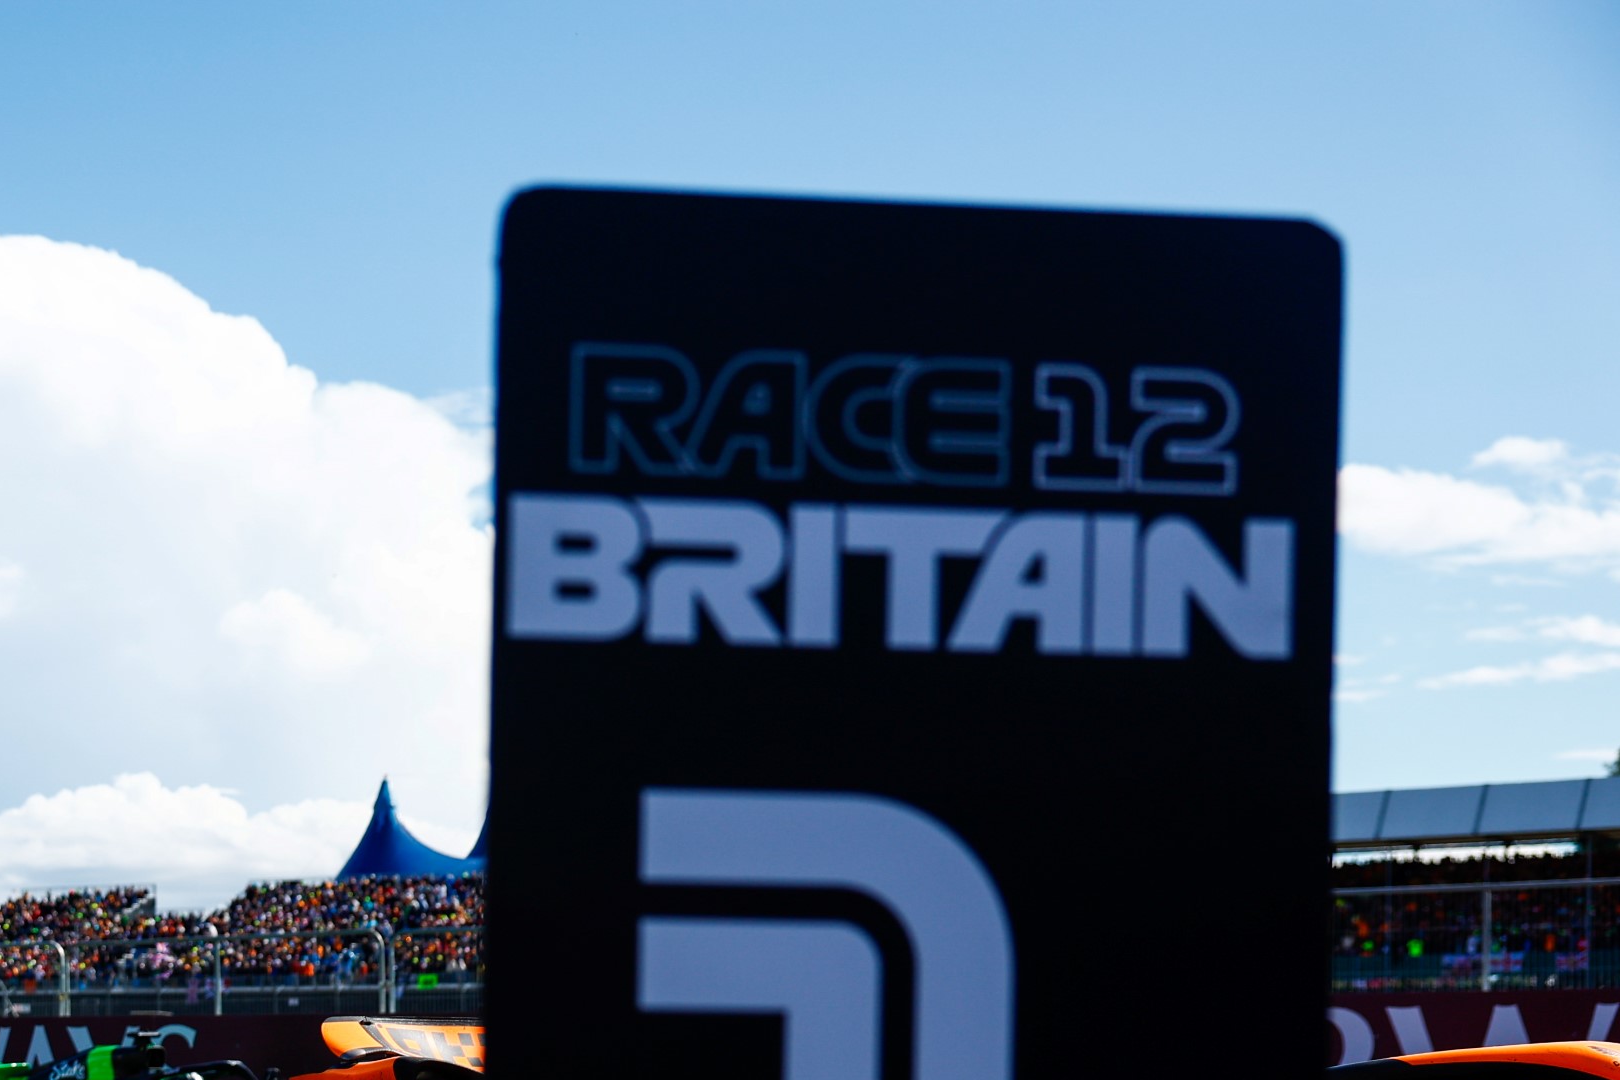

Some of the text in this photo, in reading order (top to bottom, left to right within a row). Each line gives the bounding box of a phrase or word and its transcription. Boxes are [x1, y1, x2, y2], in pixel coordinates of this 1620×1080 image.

[569, 341, 1240, 494] RACE 12
[506, 491, 1295, 660] BRITAIN
